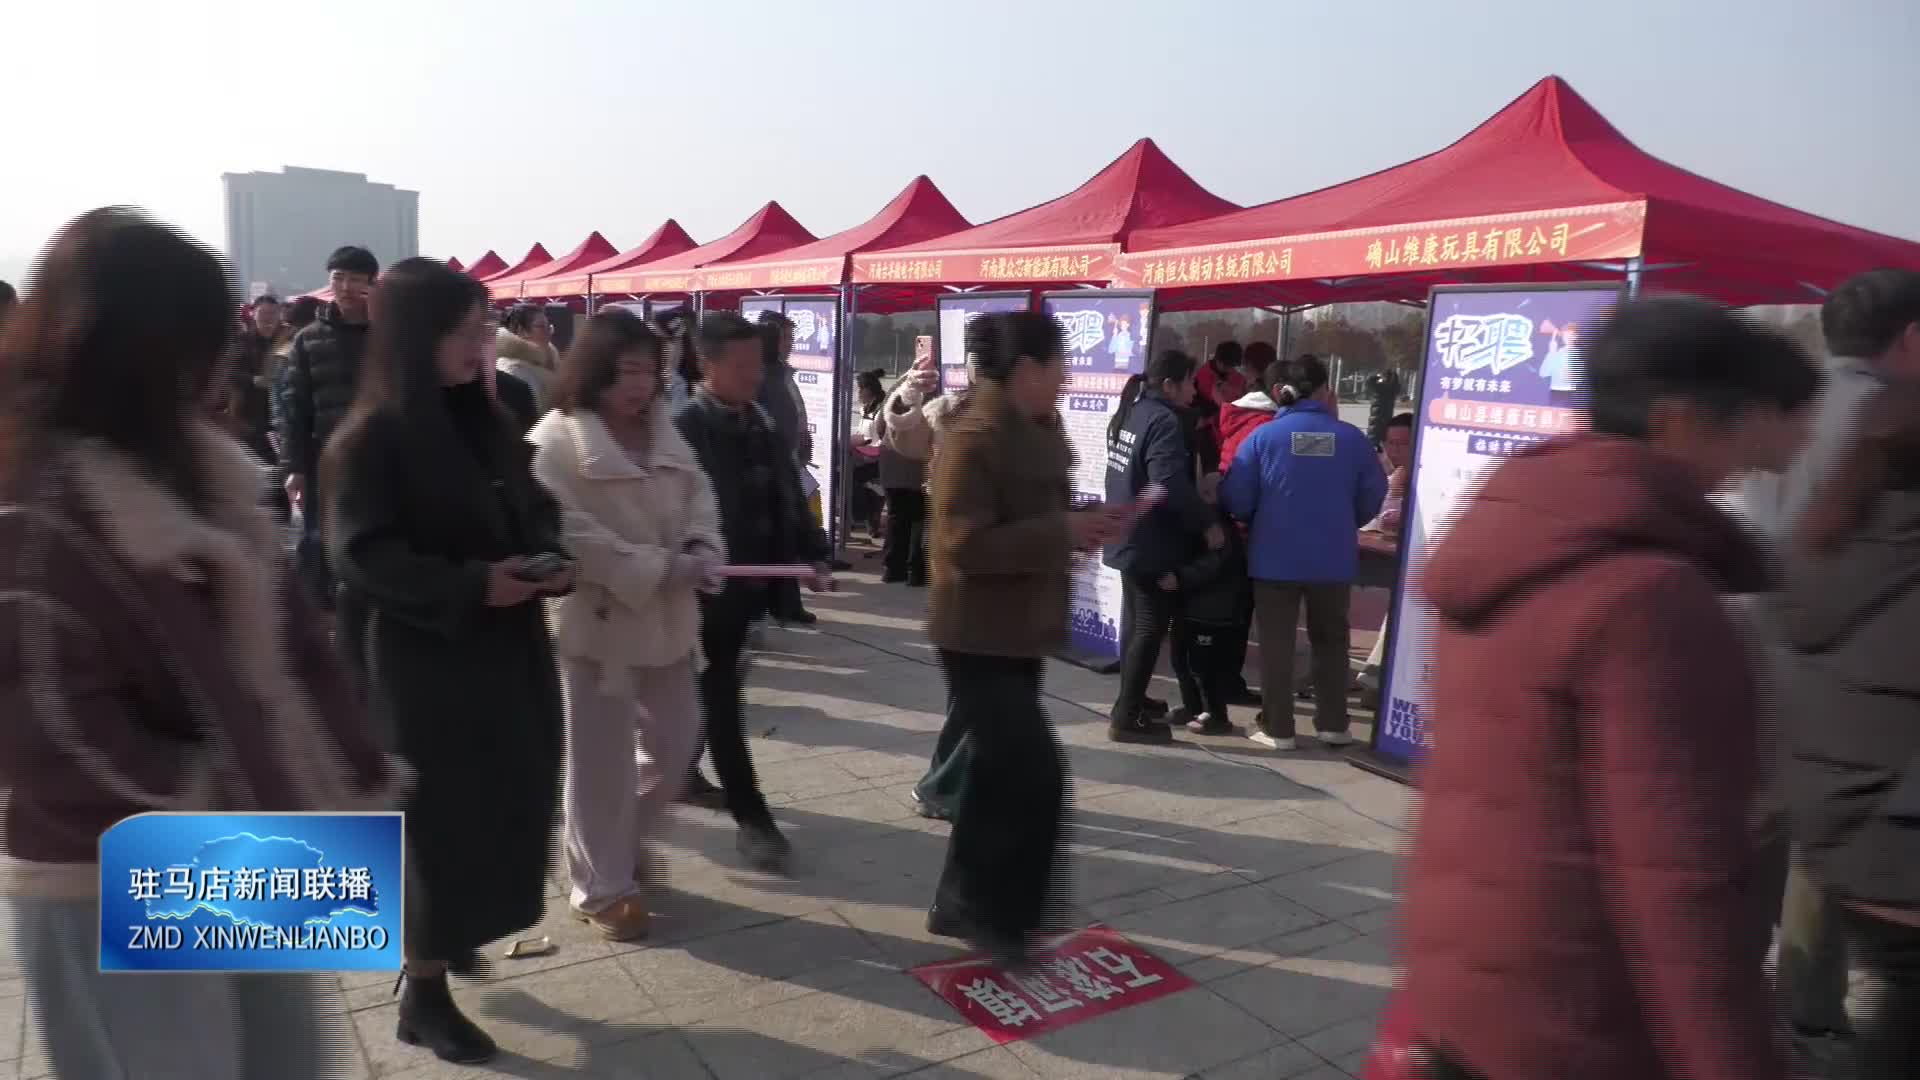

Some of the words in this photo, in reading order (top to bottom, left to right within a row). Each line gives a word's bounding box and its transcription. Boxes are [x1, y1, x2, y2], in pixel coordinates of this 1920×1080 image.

[1142, 247, 1293, 285] 河南恒久制动系统有限公司
[1365, 223, 1569, 270] 确山维康玩具有限公司
[1434, 313, 1534, 376] 招聘
